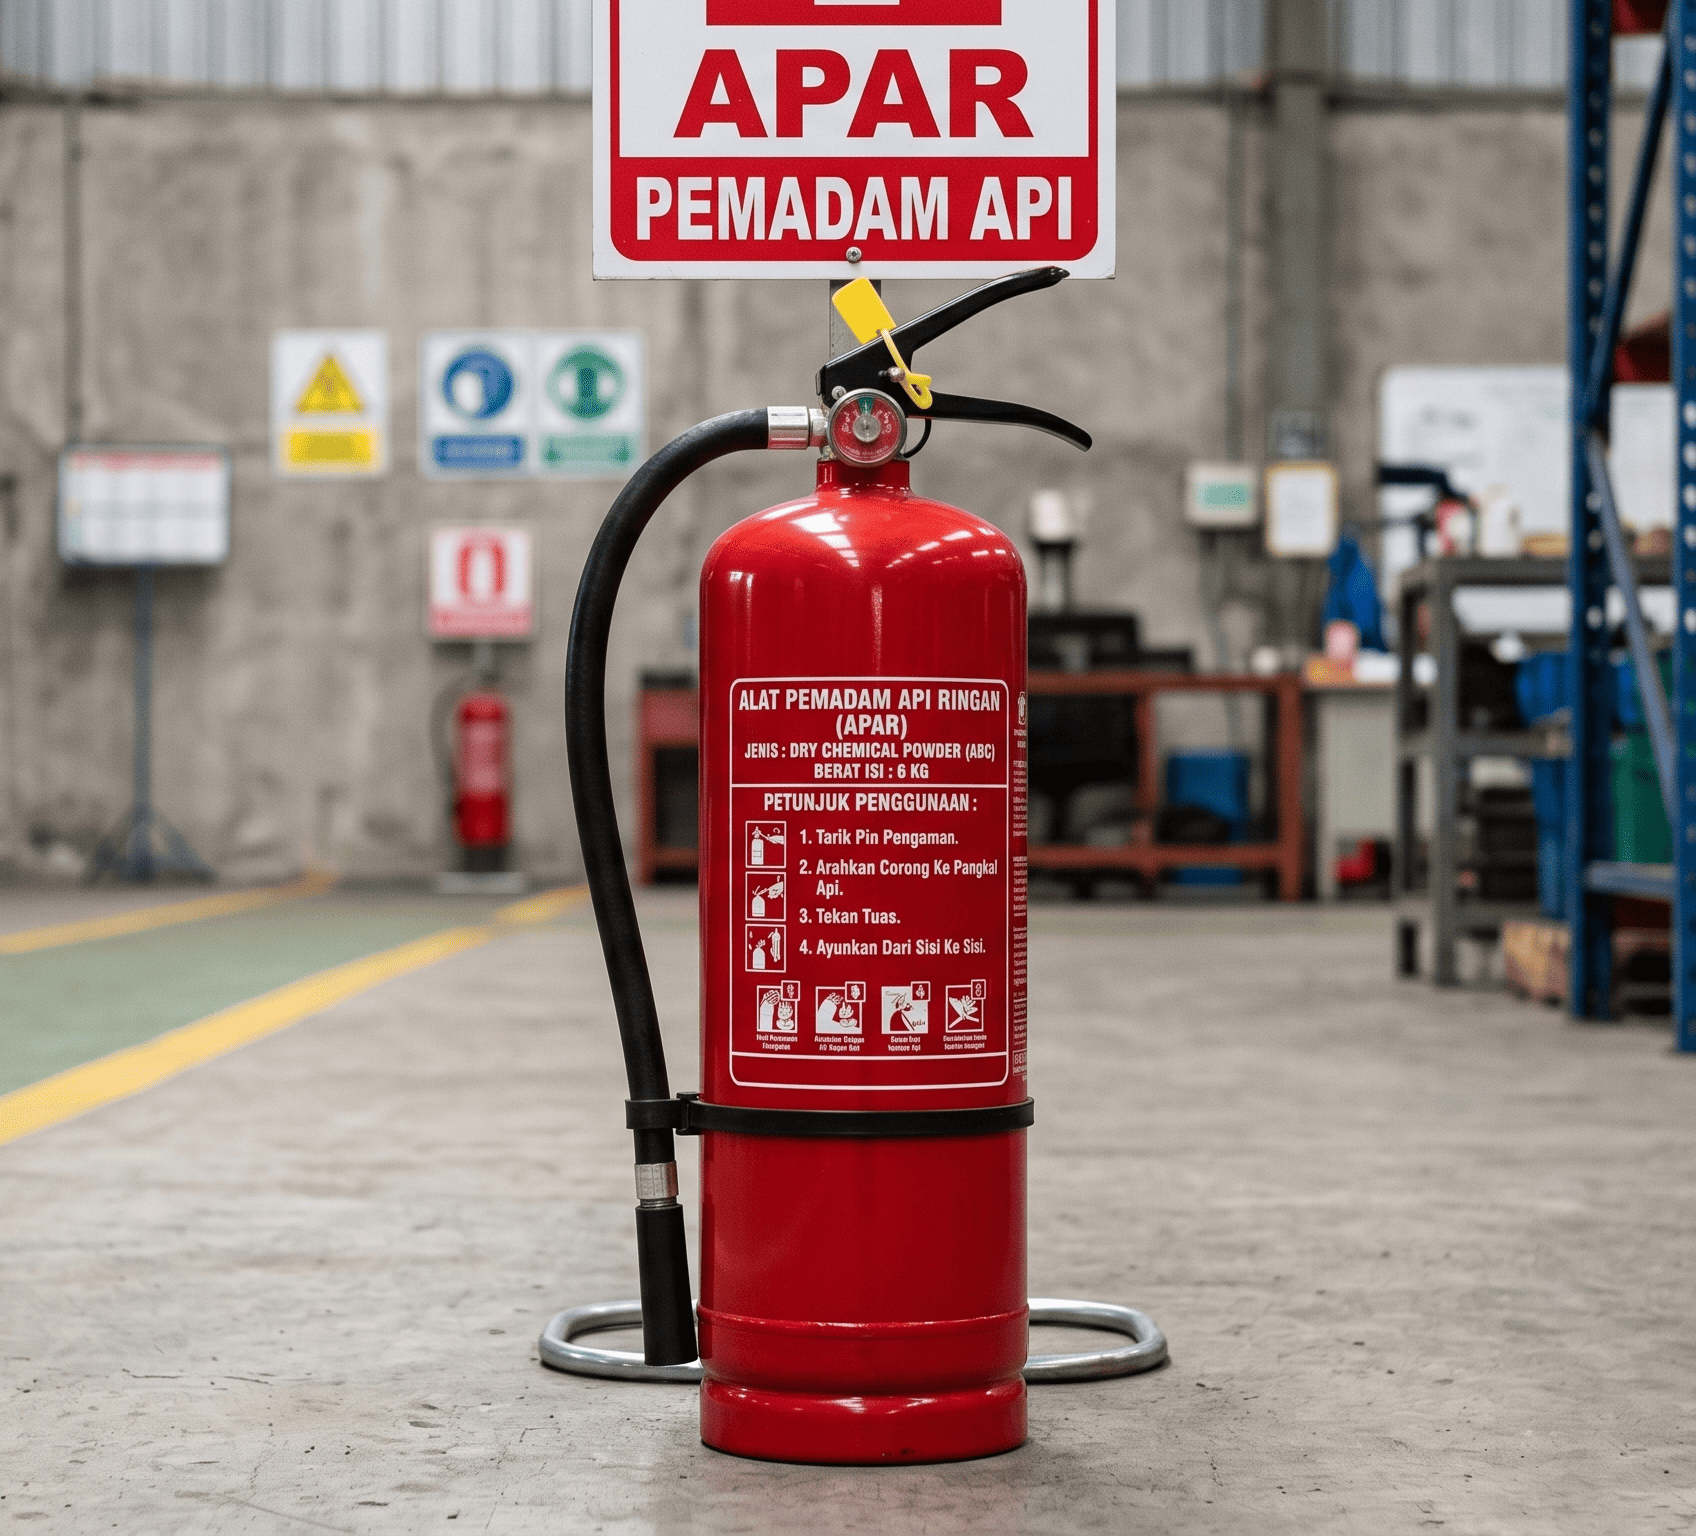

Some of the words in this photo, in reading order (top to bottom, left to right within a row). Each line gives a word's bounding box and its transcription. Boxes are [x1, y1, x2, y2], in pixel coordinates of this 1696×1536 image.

[673, 49, 1034, 138] APAR
[637, 176, 949, 241] PEMADAM
[969, 176, 1072, 241] API
[739, 688, 780, 711] ALAT
[785, 688, 891, 710] PEMADAM
[897, 688, 931, 710] API
[938, 689, 1000, 712] RINGAN
[835, 714, 908, 741] (APAR)
[744, 742, 779, 759] JENIS
[790, 742, 818, 758] DRY
[821, 742, 899, 759] CHEMICAL
[903, 742, 961, 759] POWDER
[965, 743, 995, 763] (ABC)
[814, 763, 861, 779] BERAT
[865, 763, 884, 779] ISI
[897, 763, 907, 779] 6
[910, 763, 929, 779] KG
[764, 792, 850, 812] PETUNJUK
[855, 792, 969, 812] PENGGUNAAN
[799, 828, 813, 845] 1.
[815, 828, 851, 845] Tarik
[855, 828, 879, 845] Pin
[883, 829, 959, 849] Pengaman.
[799, 858, 812, 875] 2.
[815, 858, 876, 875] Arahkan
[879, 859, 929, 879] Corong
[934, 859, 951, 875] Ke
[954, 859, 998, 879] Pangkal
[816, 879, 844, 900] Api.
[799, 907, 812, 924] 3.
[815, 907, 858, 924] Tekan
[861, 908, 901, 924] Tuas.
[799, 939, 813, 955] 4.
[816, 938, 878, 959] Ayunkan
[882, 938, 912, 955] Dari
[915, 938, 941, 955] Sisi
[944, 938, 960, 955] Ke
[963, 937, 986, 954] Sisi.
